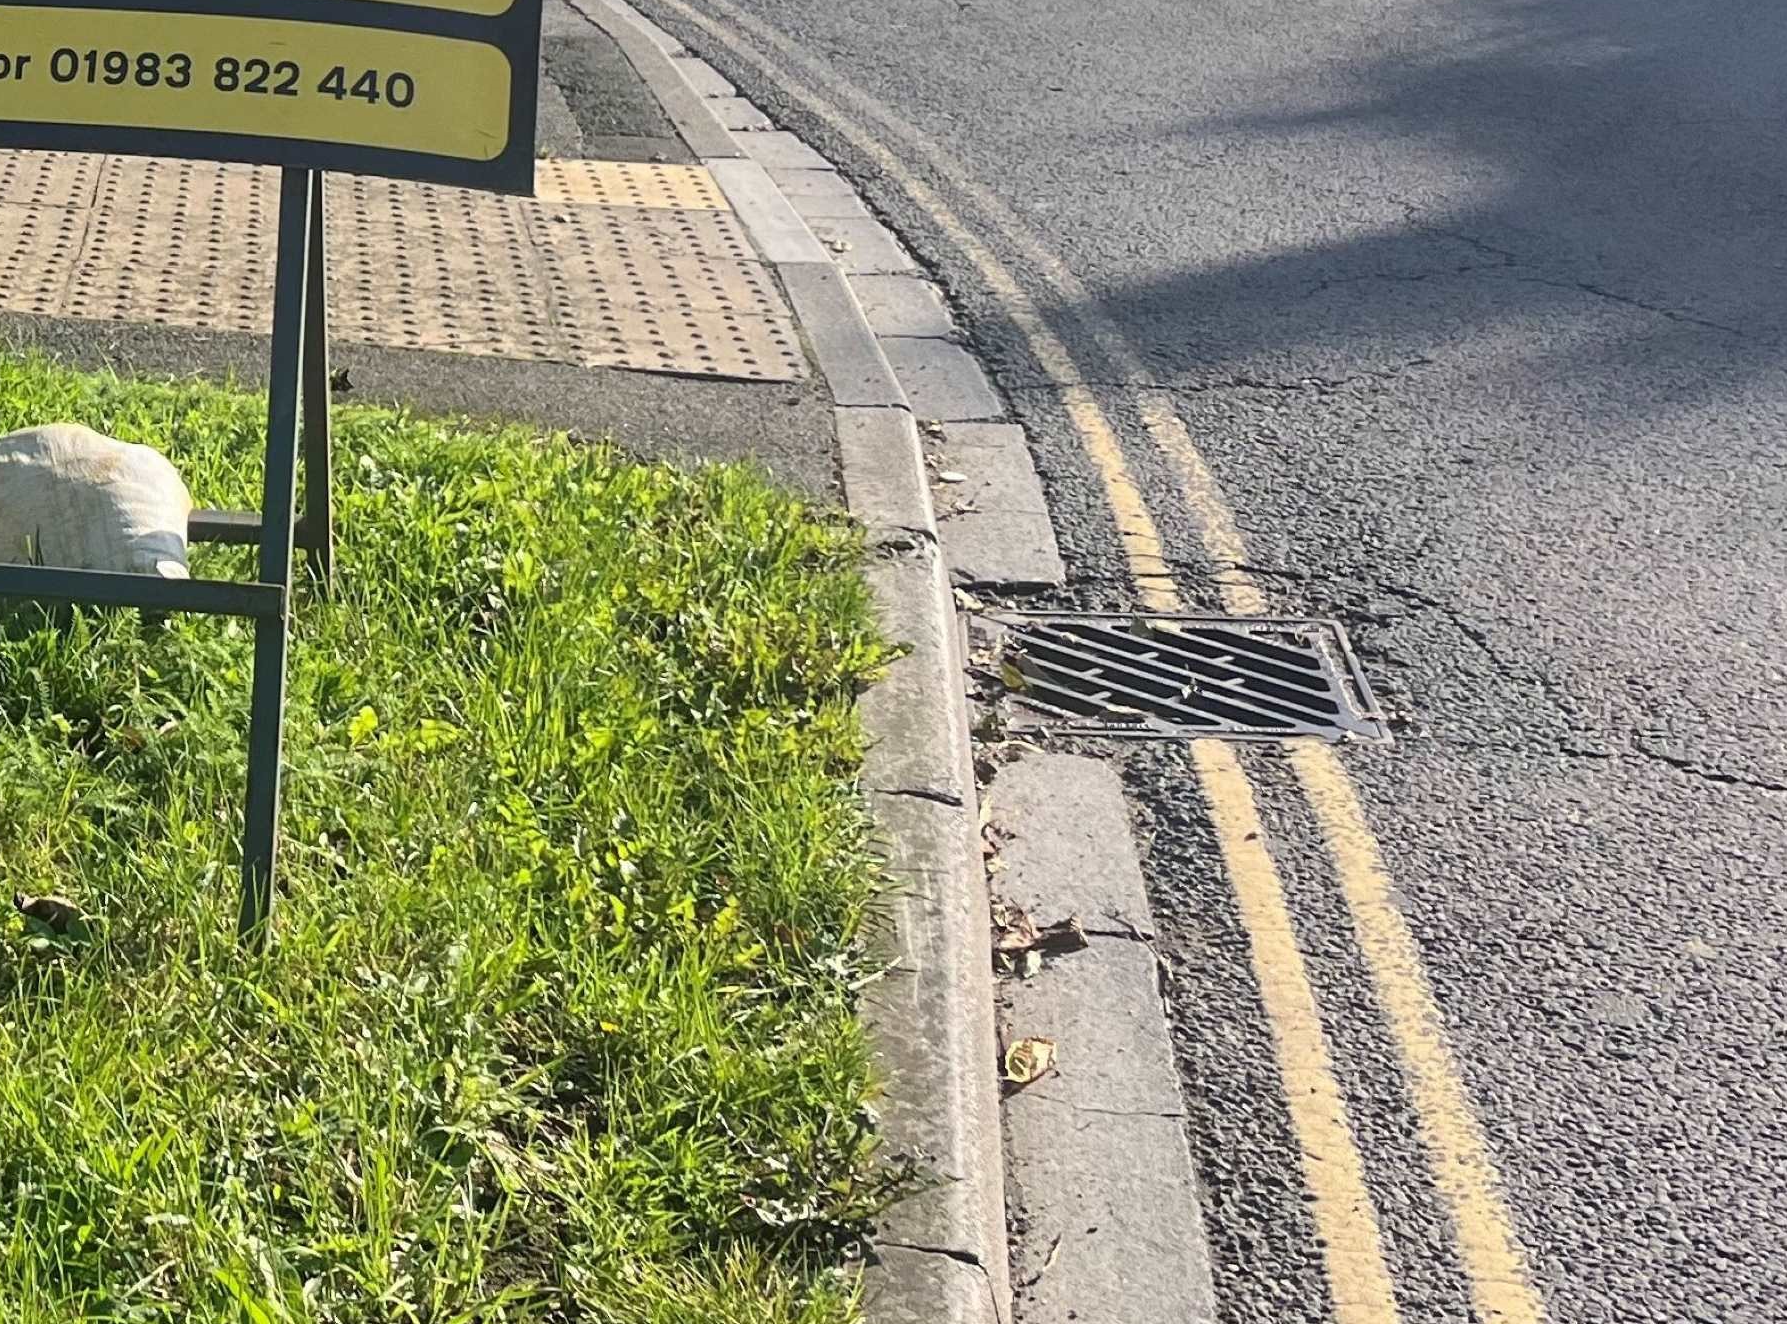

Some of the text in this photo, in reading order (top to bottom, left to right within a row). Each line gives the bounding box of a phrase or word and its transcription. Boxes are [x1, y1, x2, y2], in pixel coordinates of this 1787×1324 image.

[49, 48, 193, 89] 01983
[213, 56, 301, 97] 822
[316, 66, 416, 109] 440
